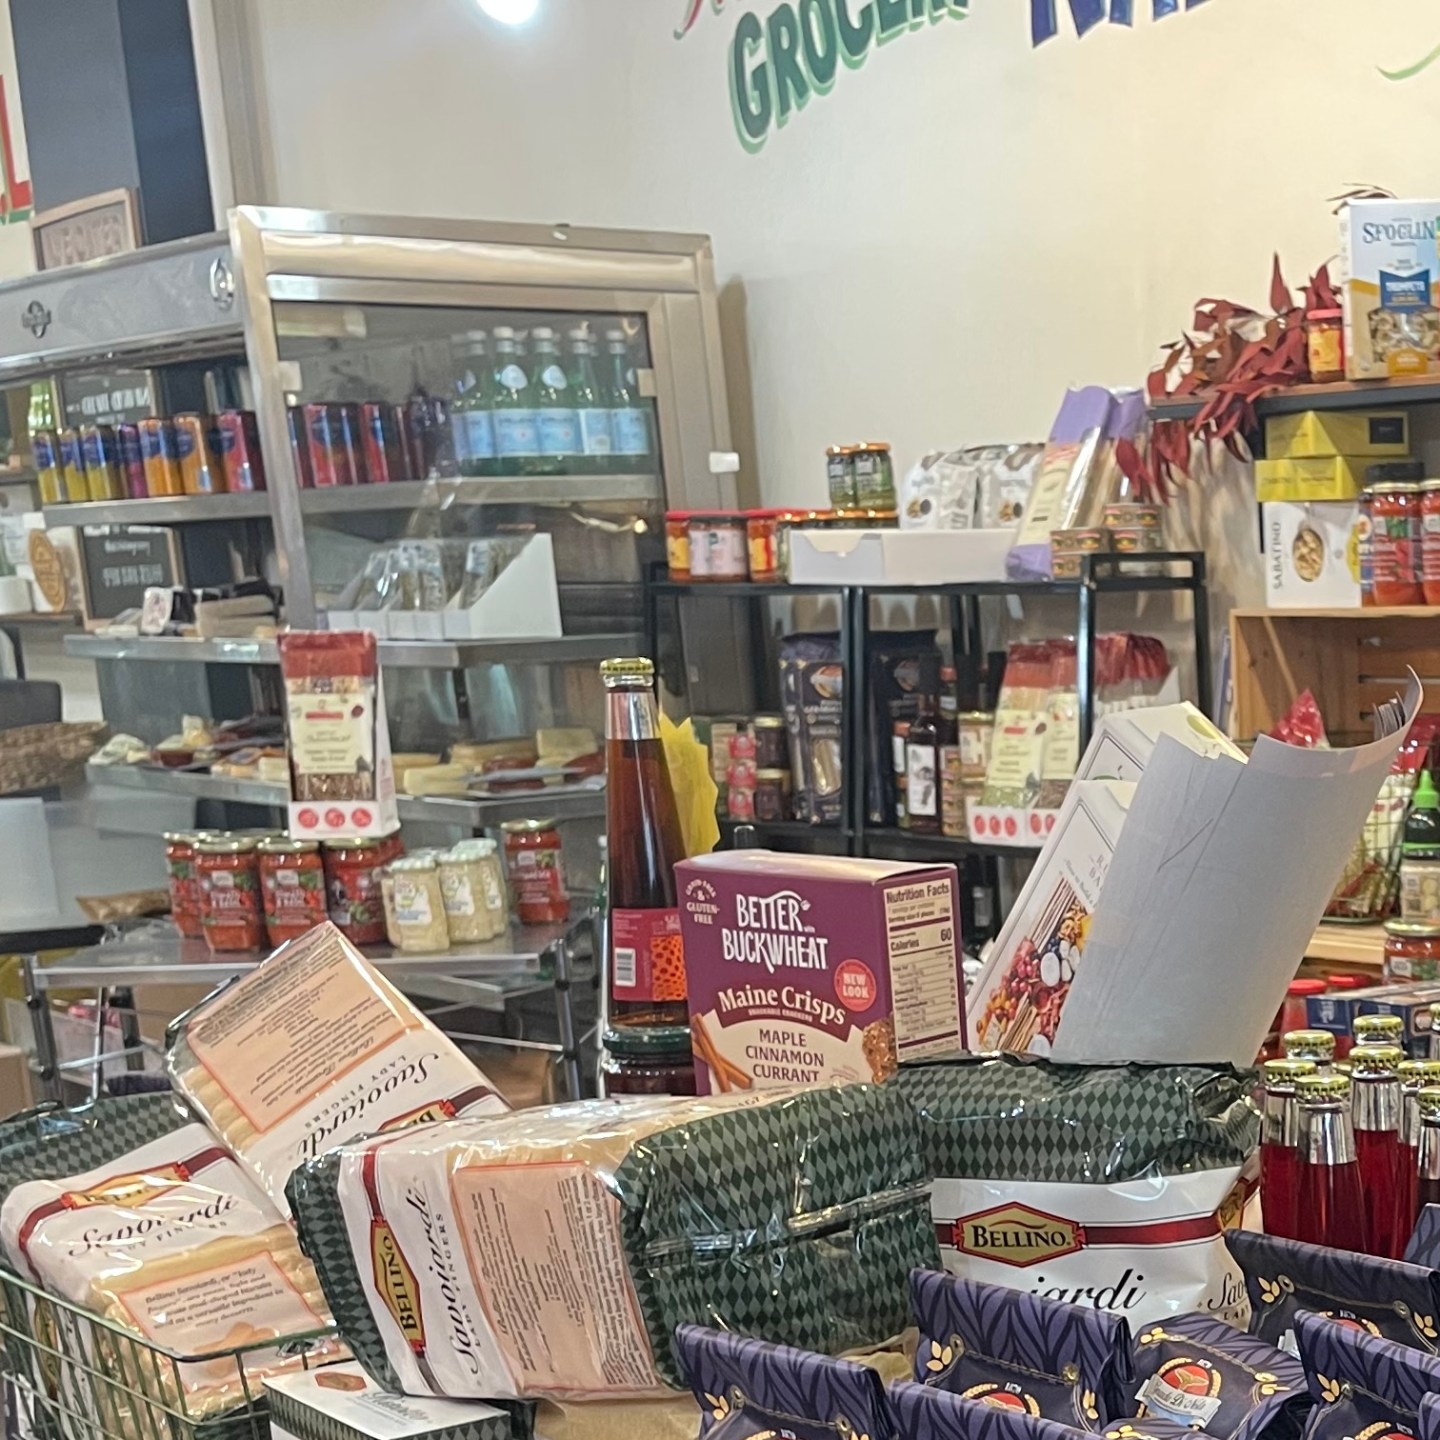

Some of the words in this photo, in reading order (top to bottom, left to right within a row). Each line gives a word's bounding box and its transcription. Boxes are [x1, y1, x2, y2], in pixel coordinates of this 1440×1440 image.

[728, 0, 970, 153] GROC
[1363, 221, 1436, 243] SFOGLIN
[1273, 522, 1281, 589] SABATINO
[886, 887, 925, 904] Nutrition
[927, 882, 950, 896] Facts
[736, 890, 804, 932] BETTER
[722, 928, 828, 974] BUCKWHEAT
[891, 937, 919, 952] Calories
[940, 928, 952, 942] 60
[843, 973, 866, 986] NEW
[843, 984, 869, 998] LOOK
[718, 984, 778, 1013] Maine
[781, 986, 846, 1025] Crisps
[759, 1028, 806, 1047] MAPLE
[371, 1055, 407, 1081] LADY
[745, 1045, 824, 1067] CINNAMON
[753, 1064, 819, 1083] CURRANT
[297, 1053, 439, 1161] Savoiardi
[304, 1084, 364, 1129] FINGERS
[971, 1224, 1071, 1248] BELLINO
[406, 1188, 479, 1375] Savoiardi
